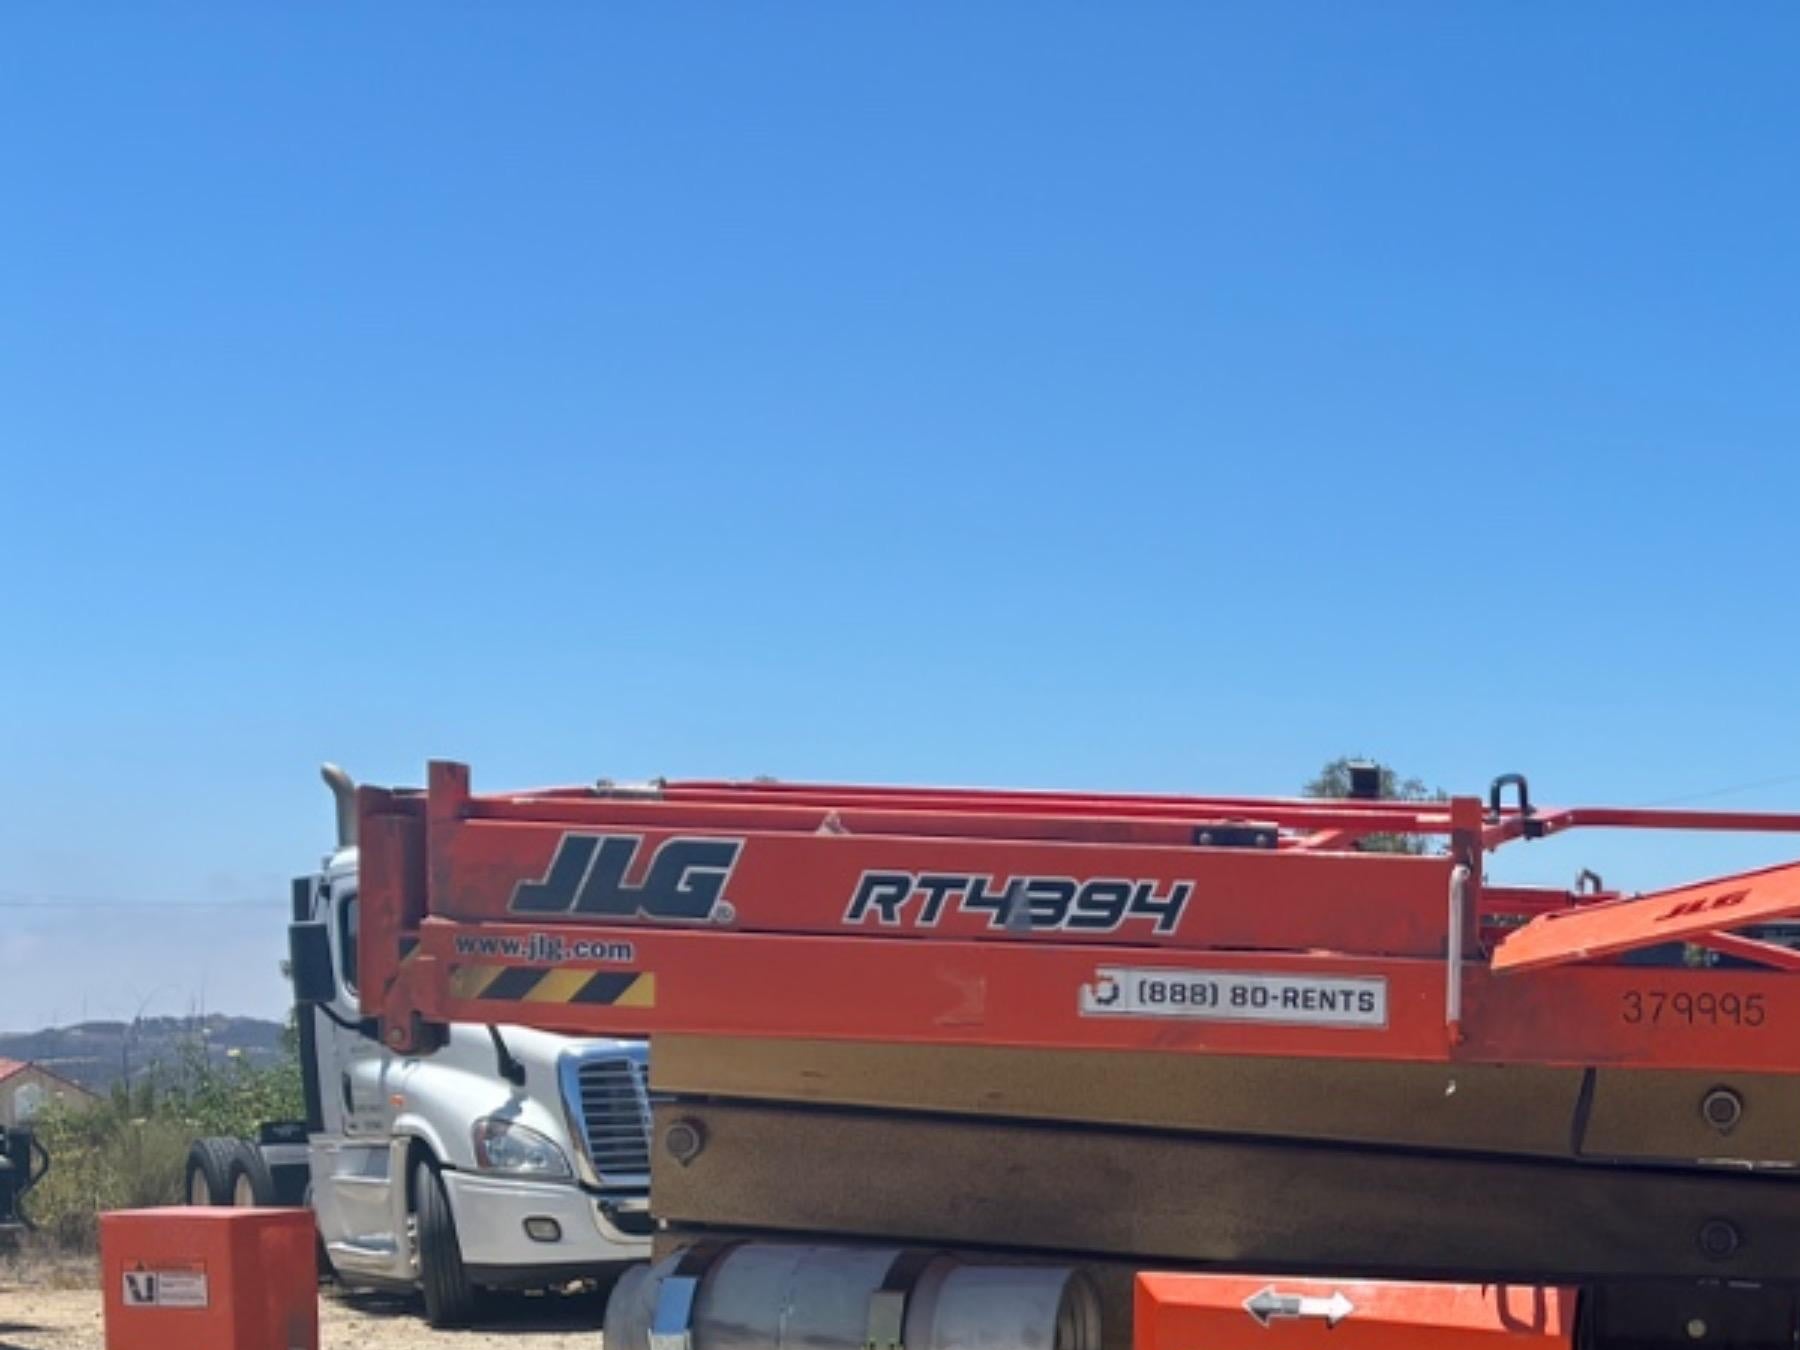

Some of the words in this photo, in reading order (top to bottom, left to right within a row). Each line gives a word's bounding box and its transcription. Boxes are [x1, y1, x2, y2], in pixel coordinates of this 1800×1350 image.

[507, 831, 747, 923] JLG
[842, 869, 1196, 936] RT4394
[455, 933, 633, 962] www.jlg.com
[1138, 979, 1219, 1008] (888)
[1229, 985, 1376, 1013] 80-RENTS
[1622, 990, 1765, 1027] 379995
